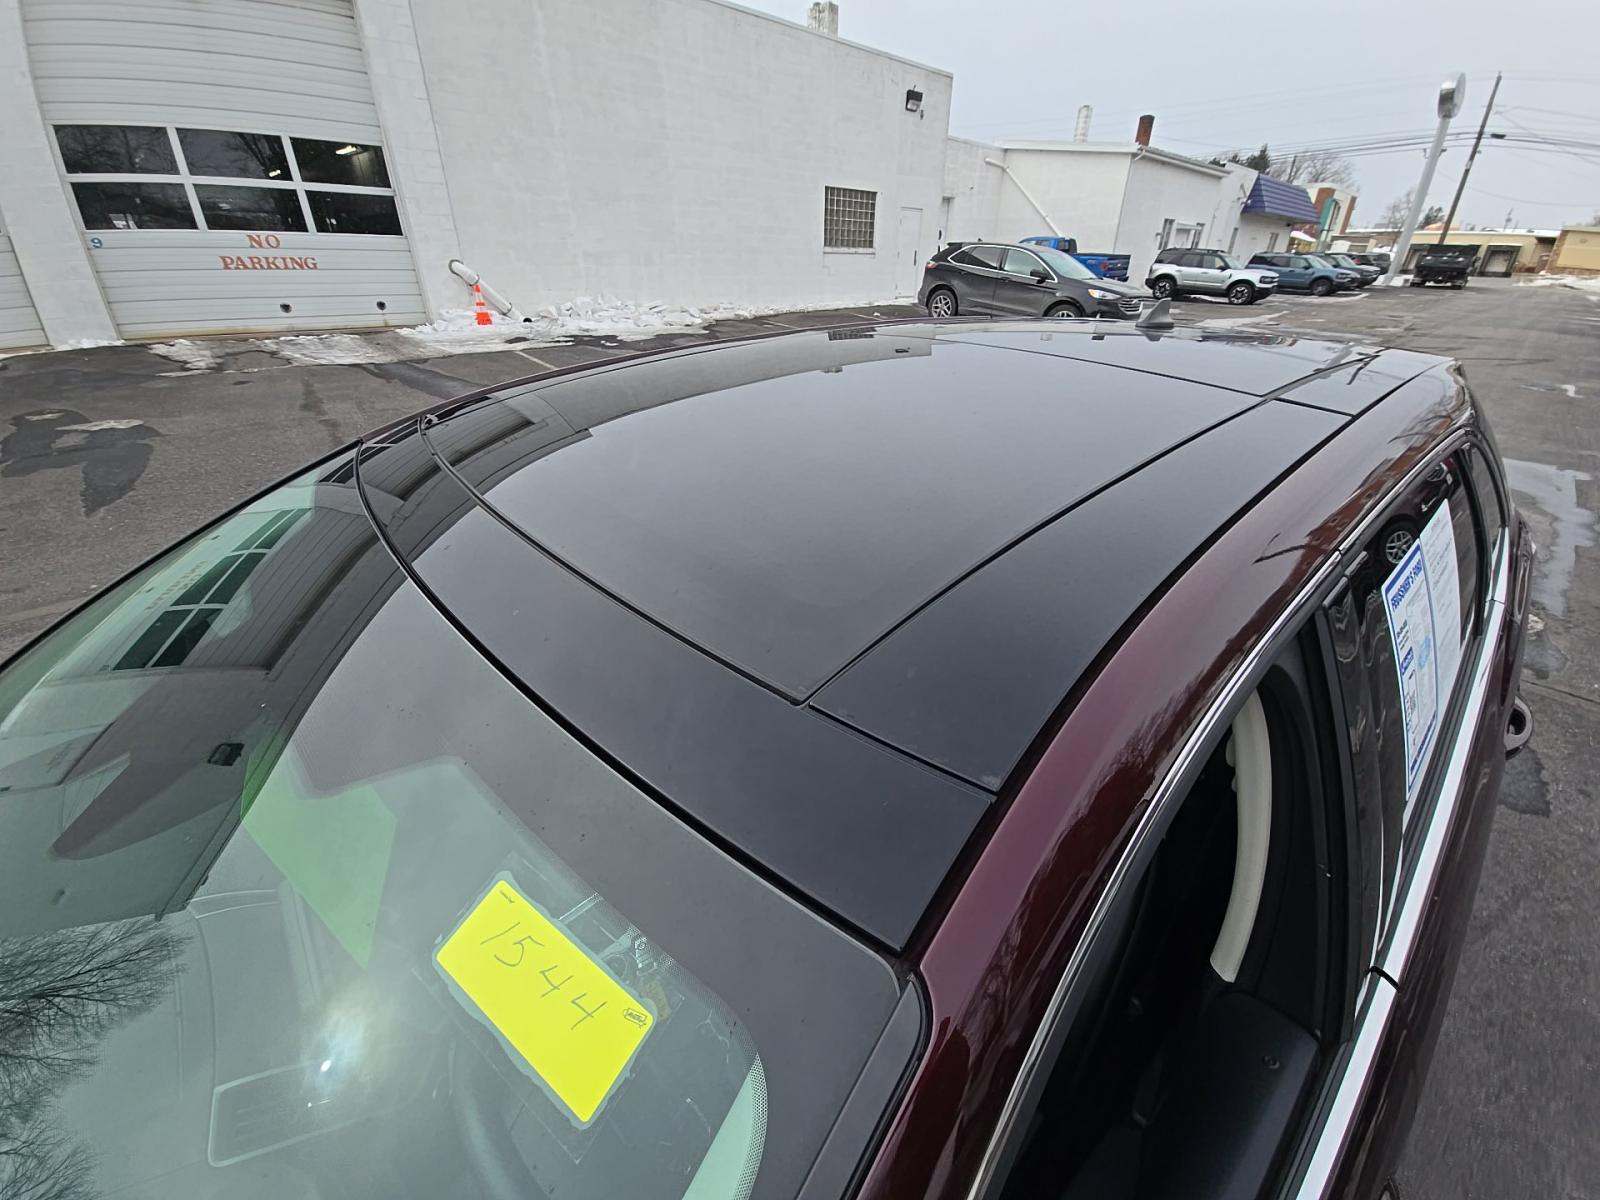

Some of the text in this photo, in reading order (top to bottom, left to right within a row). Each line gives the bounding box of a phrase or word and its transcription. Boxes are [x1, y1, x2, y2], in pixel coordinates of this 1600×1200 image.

[91, 237, 103, 249] 9
[246, 234, 281, 249] NO
[219, 255, 319, 270] PARKING
[480, 922, 608, 1030] 1544
